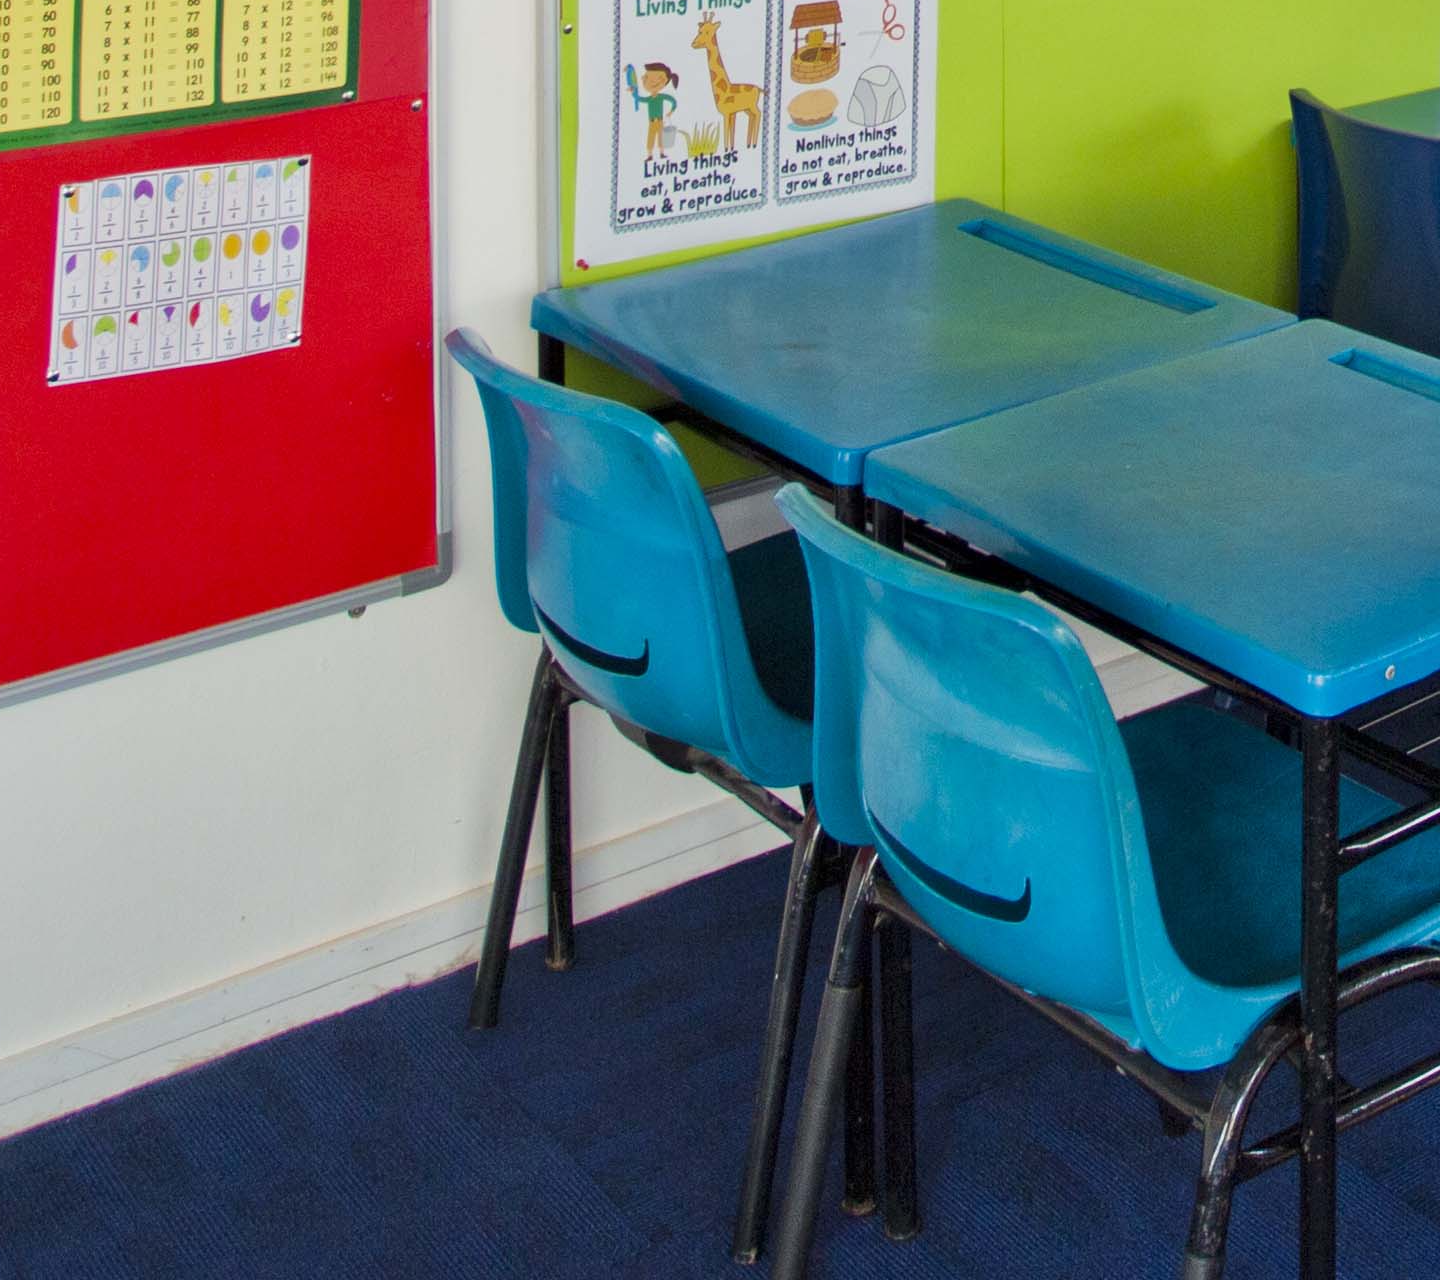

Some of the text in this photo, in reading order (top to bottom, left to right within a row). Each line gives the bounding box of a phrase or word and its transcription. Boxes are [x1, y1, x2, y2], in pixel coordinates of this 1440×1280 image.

[796, 125, 897, 152] Nonliving things
[644, 149, 738, 178] Living things
[781, 144, 907, 174] do not eat, breathe,
[641, 172, 736, 199] eat, breathe,
[785, 164, 907, 195] grow & reproduce.
[617, 187, 762, 224] grow & reproduce.
